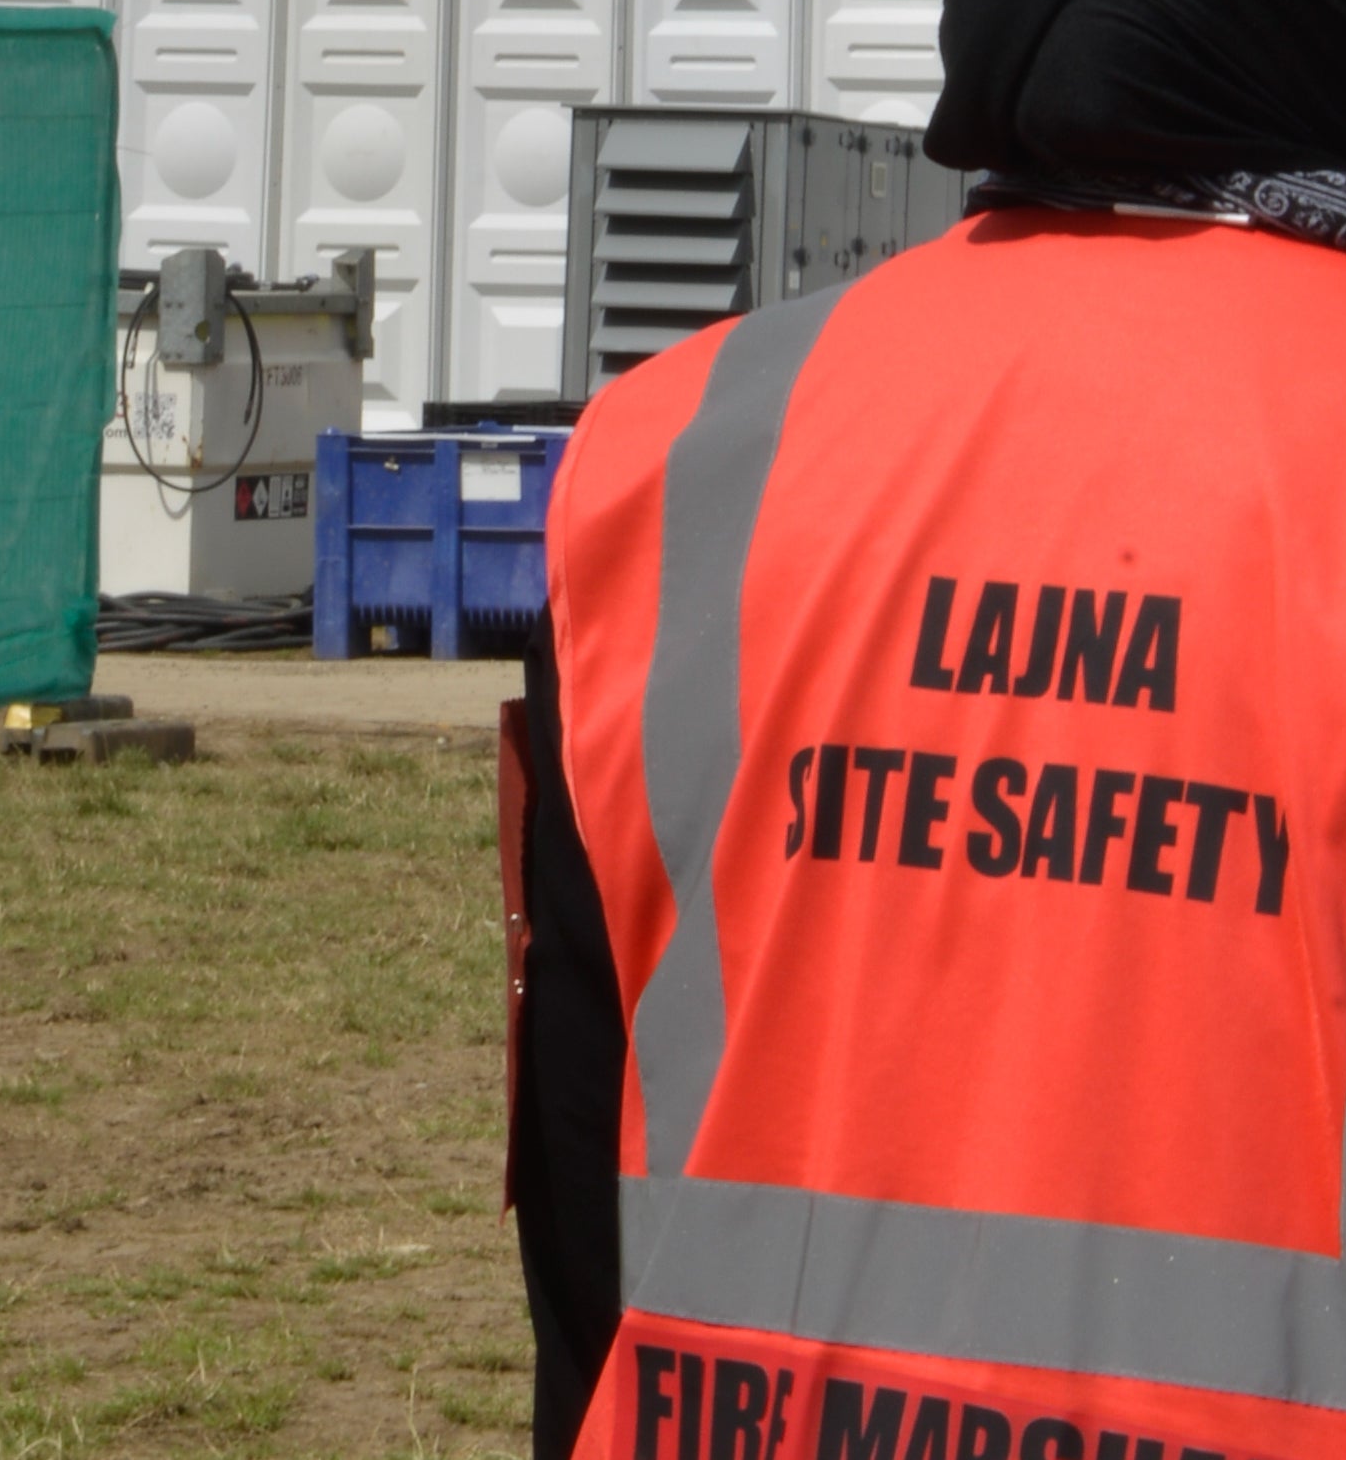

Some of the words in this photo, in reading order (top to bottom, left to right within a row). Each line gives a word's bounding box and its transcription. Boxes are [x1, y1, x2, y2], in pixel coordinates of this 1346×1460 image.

[910, 575, 1182, 712] LAJNA
[785, 743, 959, 870] SITE
[965, 757, 1291, 917] SAFETY
